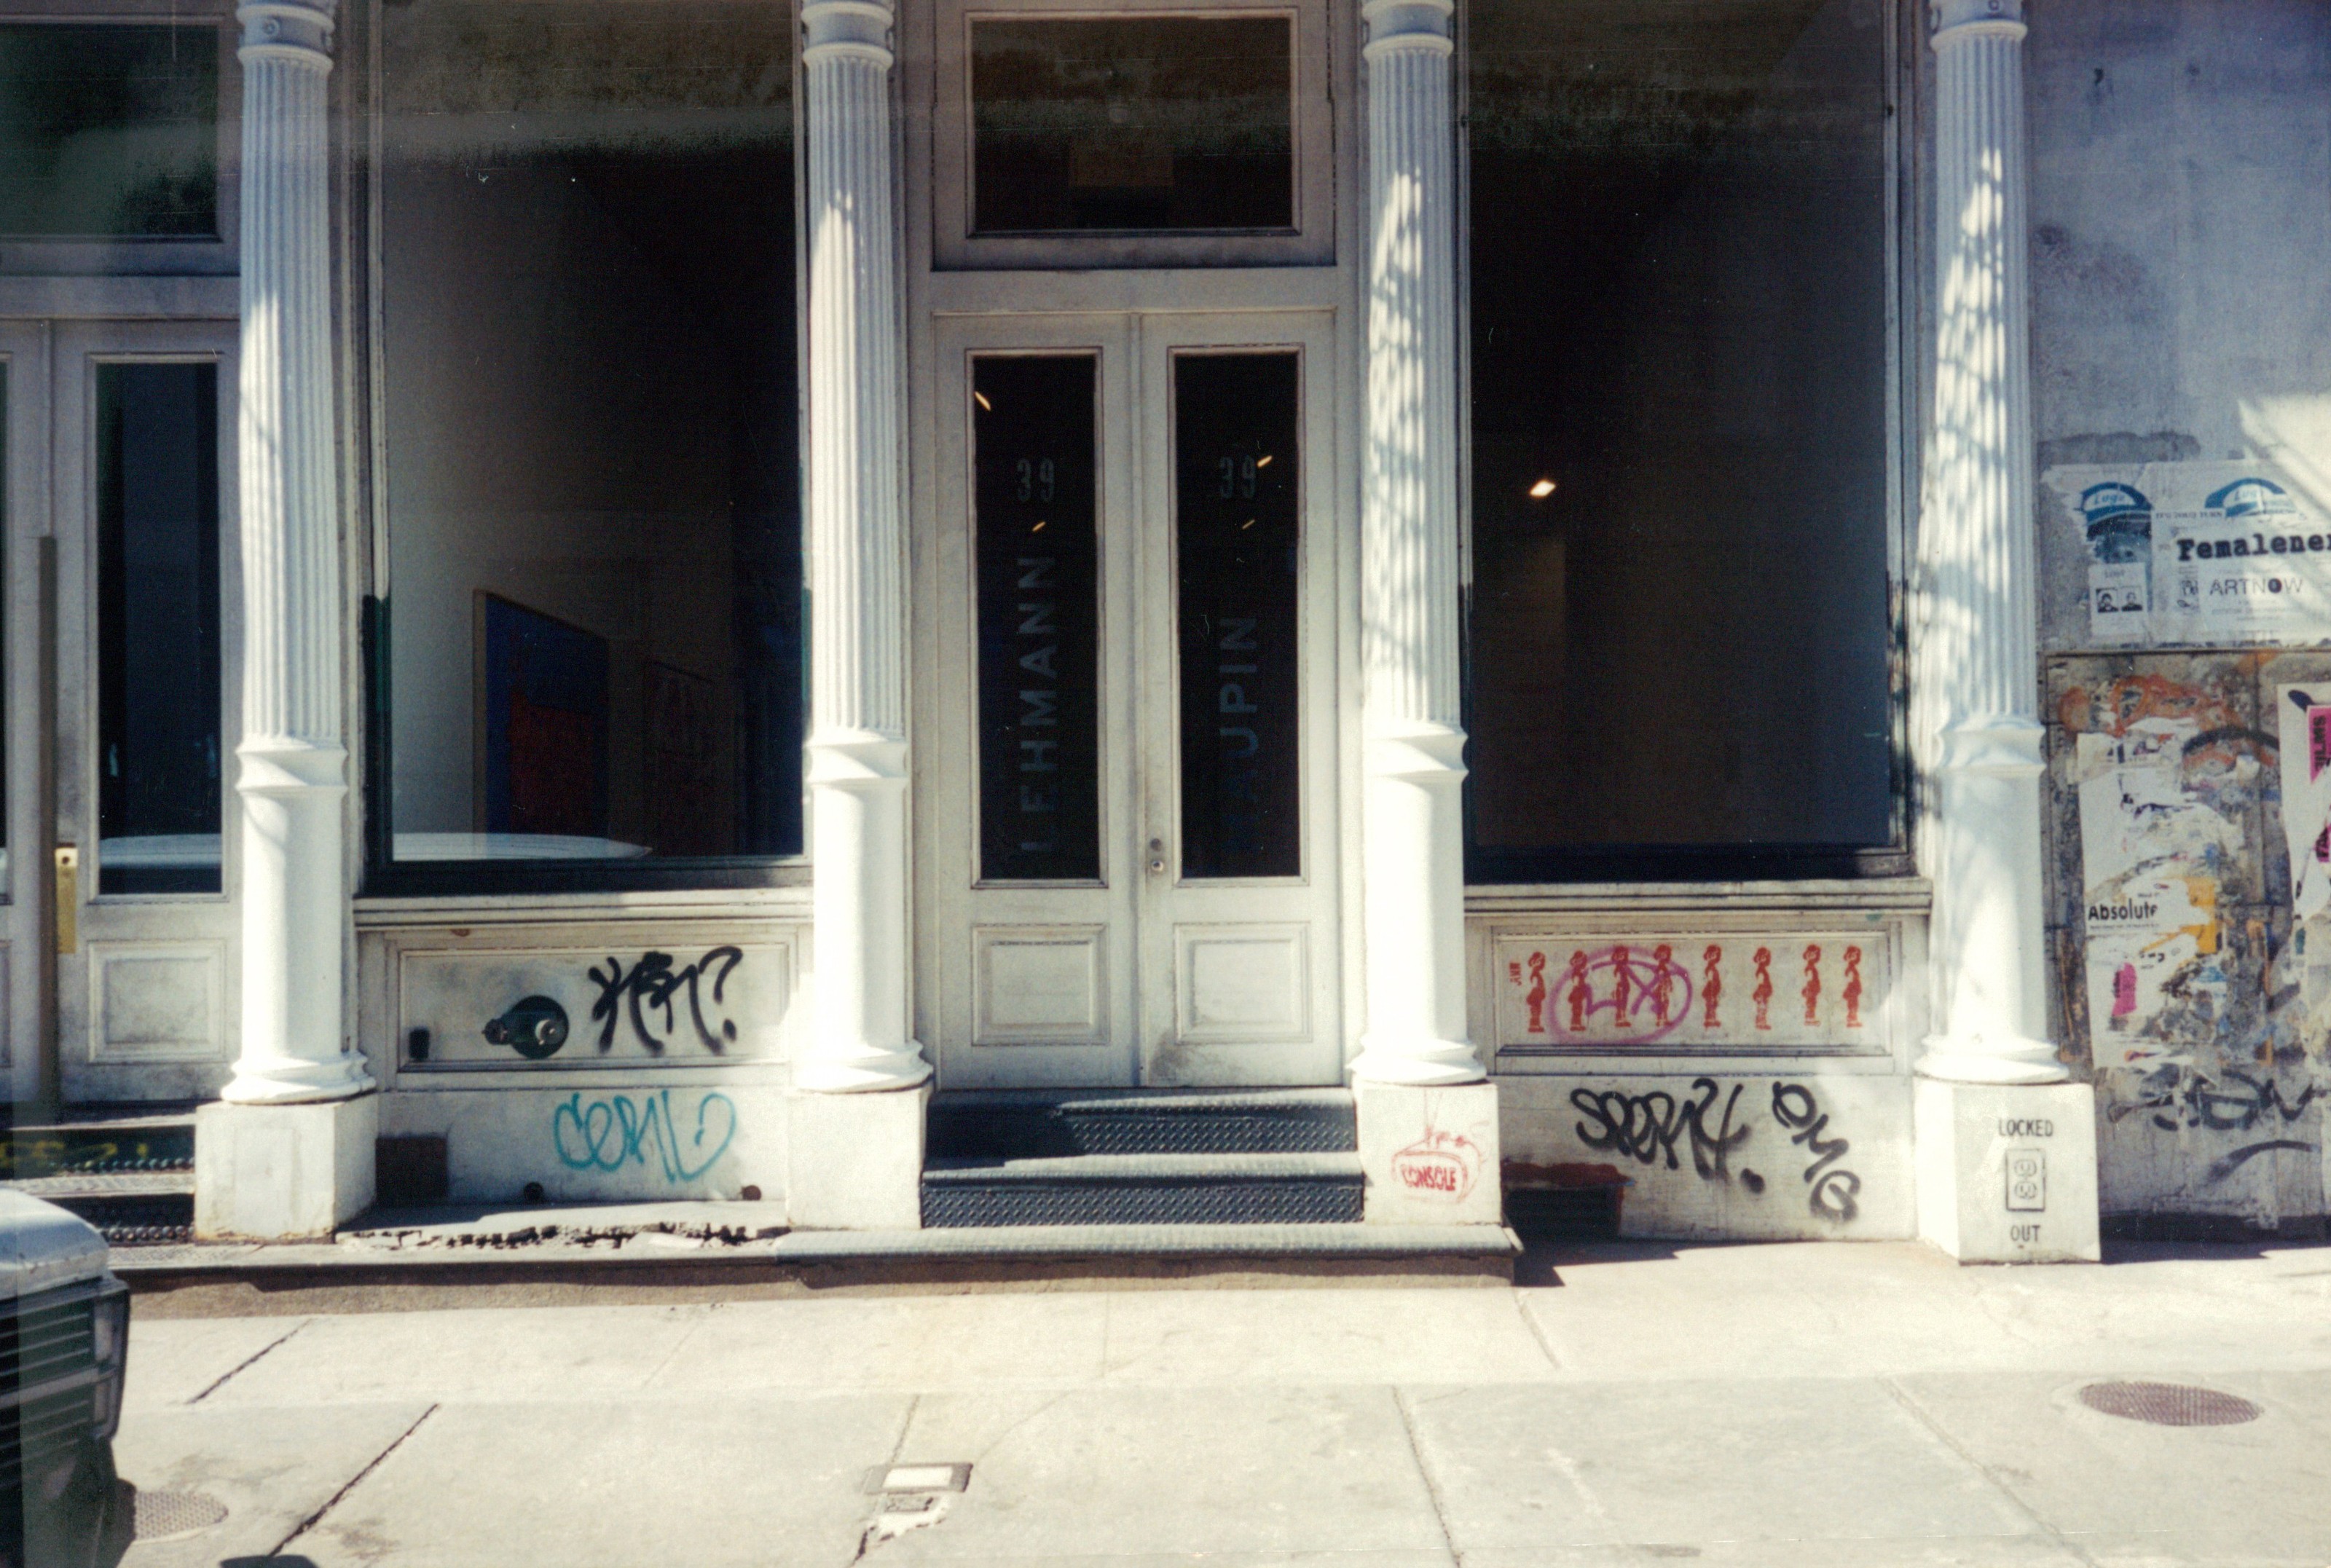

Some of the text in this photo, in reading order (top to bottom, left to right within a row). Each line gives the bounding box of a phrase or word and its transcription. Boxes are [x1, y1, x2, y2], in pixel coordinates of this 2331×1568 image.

[1017, 458, 1055, 503] 39
[1219, 456, 1256, 500] 39
[2177, 533, 2331, 562] Femalene
[1999, 1119, 2053, 1137] LOCKED
[2010, 1225, 2040, 1242] OUT
